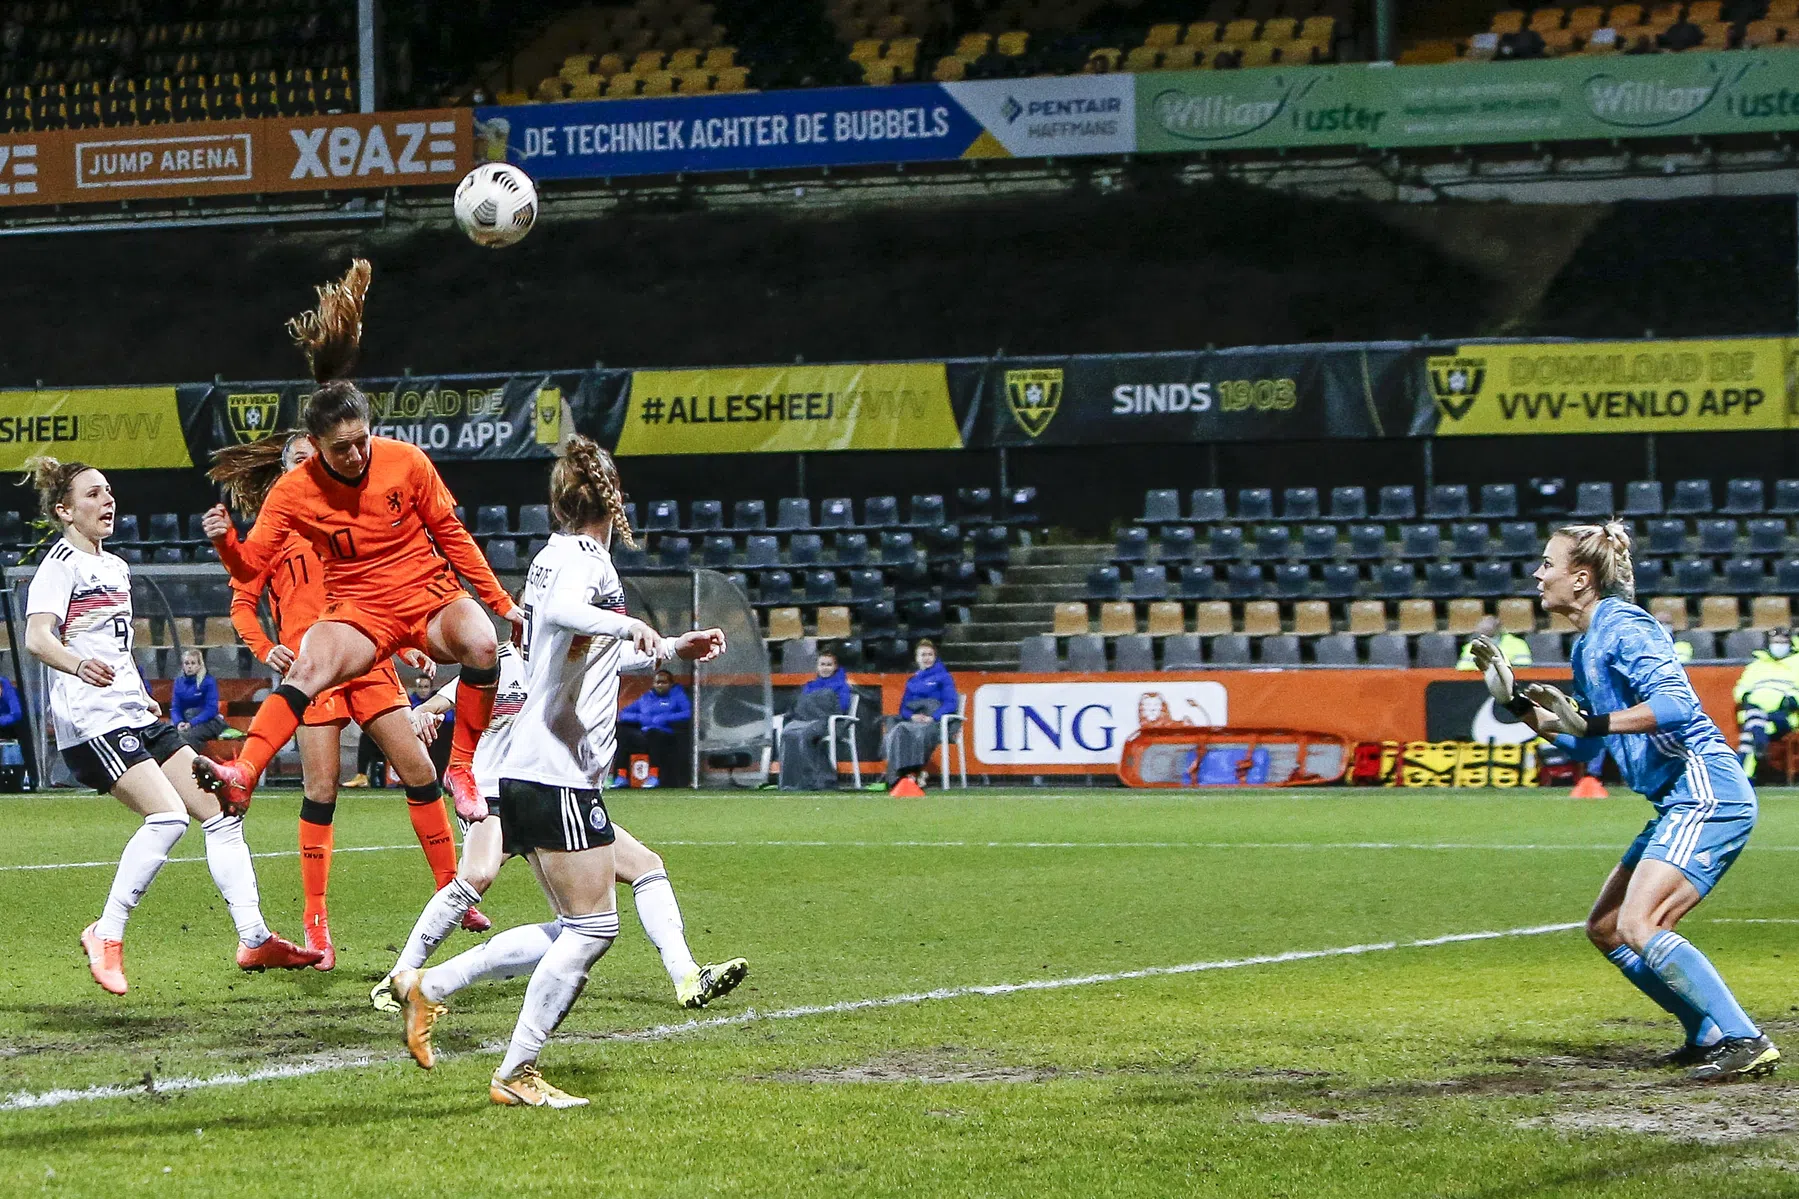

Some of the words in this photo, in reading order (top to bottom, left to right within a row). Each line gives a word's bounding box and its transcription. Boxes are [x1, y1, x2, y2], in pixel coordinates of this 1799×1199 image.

[1027, 97, 1121, 116] PENTAIR
[525, 127, 557, 157] DE
[563, 120, 685, 155] TECHNIEK
[691, 115, 789, 149] ACHTER
[795, 113, 829, 144] DE
[834, 106, 949, 142] BUBBELS
[89, 152, 153, 176] JUMP
[160, 147, 239, 172] ARENA
[1507, 352, 1702, 387] DOWNLOAD
[1708, 351, 1756, 383] DE
[467, 387, 504, 416] DE
[1111, 381, 1212, 415] SINDS
[1217, 377, 1297, 412] 1903
[1497, 389, 1690, 420] VVV-VENLO
[1698, 387, 1766, 416] APP
[456, 420, 514, 449] APP
[328, 527, 357, 559] 10
[283, 553, 310, 587] 11
[114, 617, 130, 652] 9
[989, 703, 1117, 752] ING
